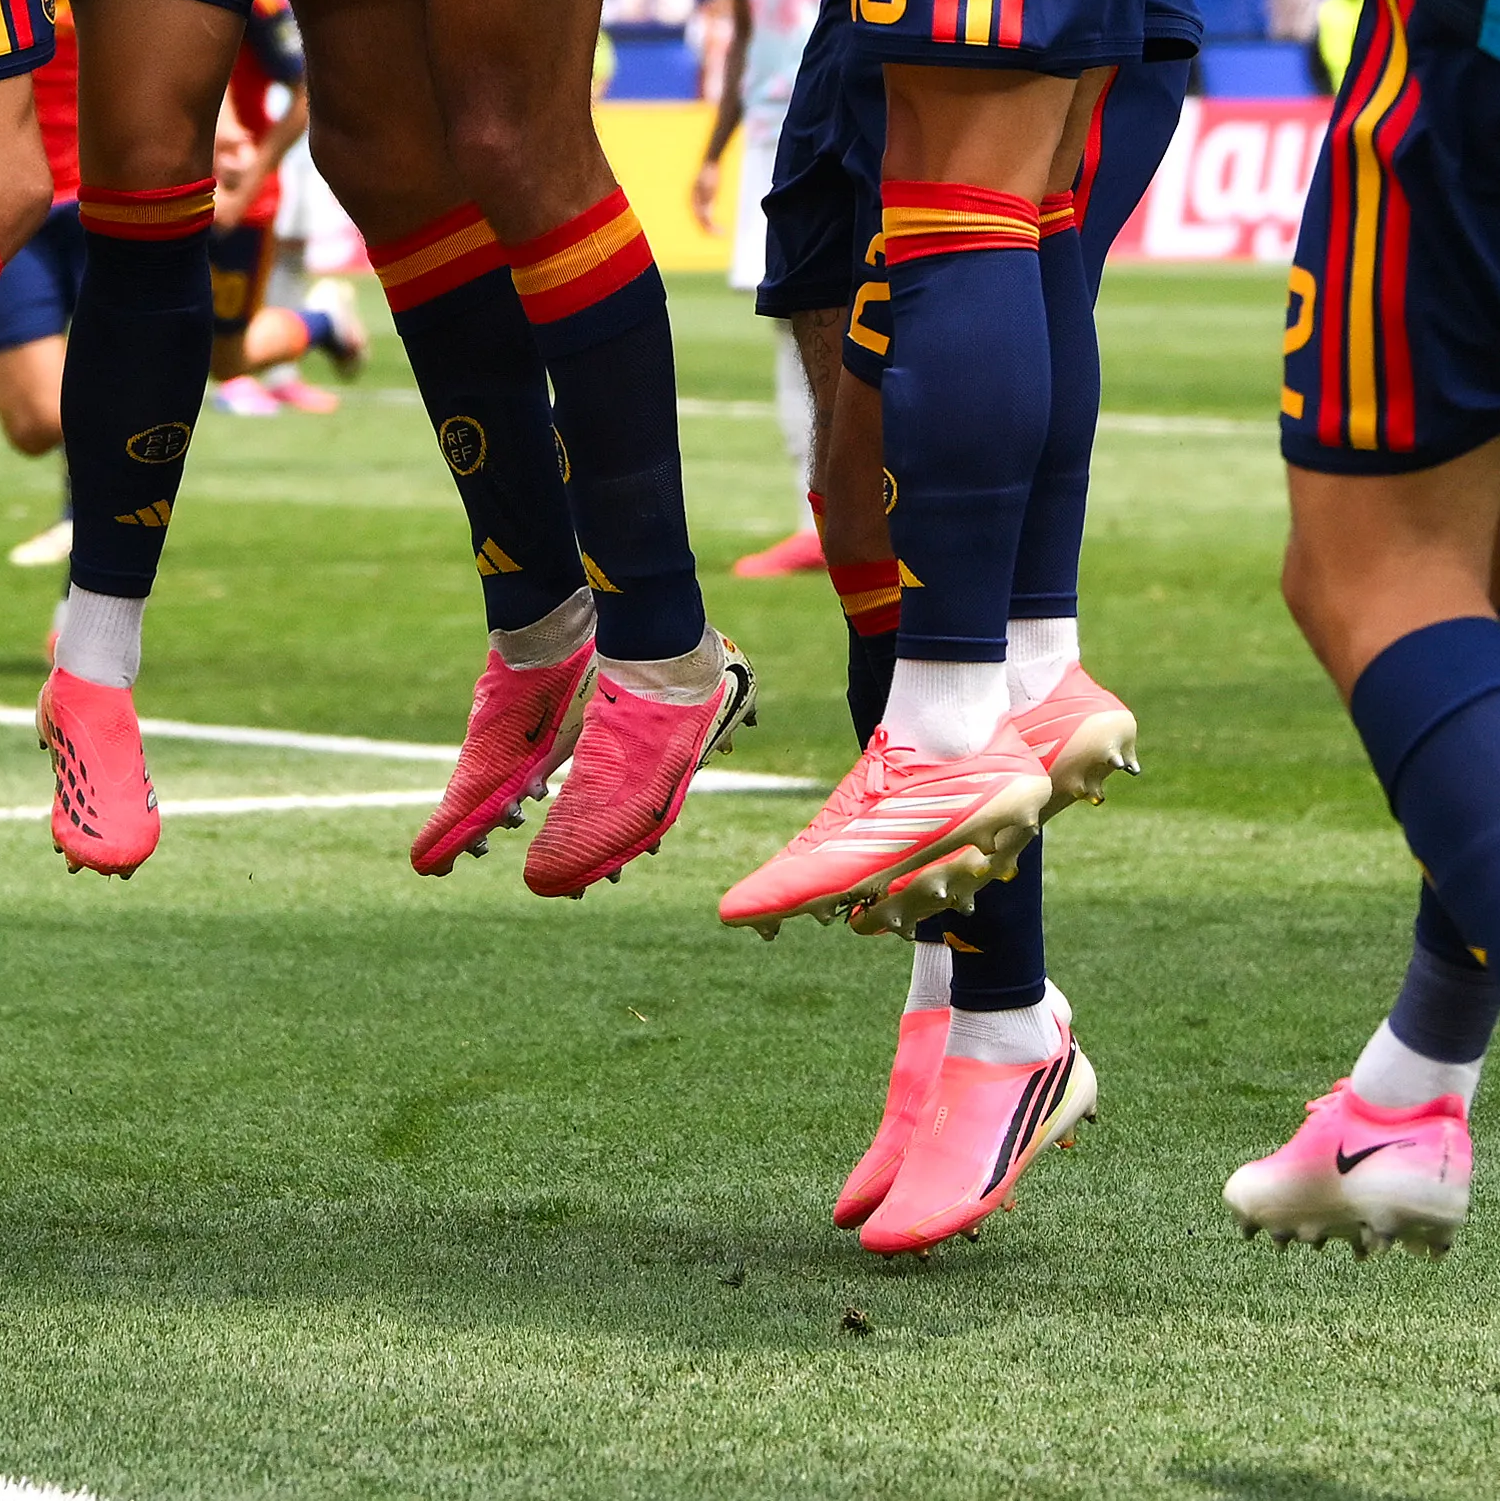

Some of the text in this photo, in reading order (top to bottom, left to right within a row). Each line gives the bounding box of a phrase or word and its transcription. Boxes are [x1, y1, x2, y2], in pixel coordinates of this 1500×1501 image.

[1142, 97, 1327, 264] Lay
[446, 427, 469, 447] RF
[451, 445, 473, 465] EF
